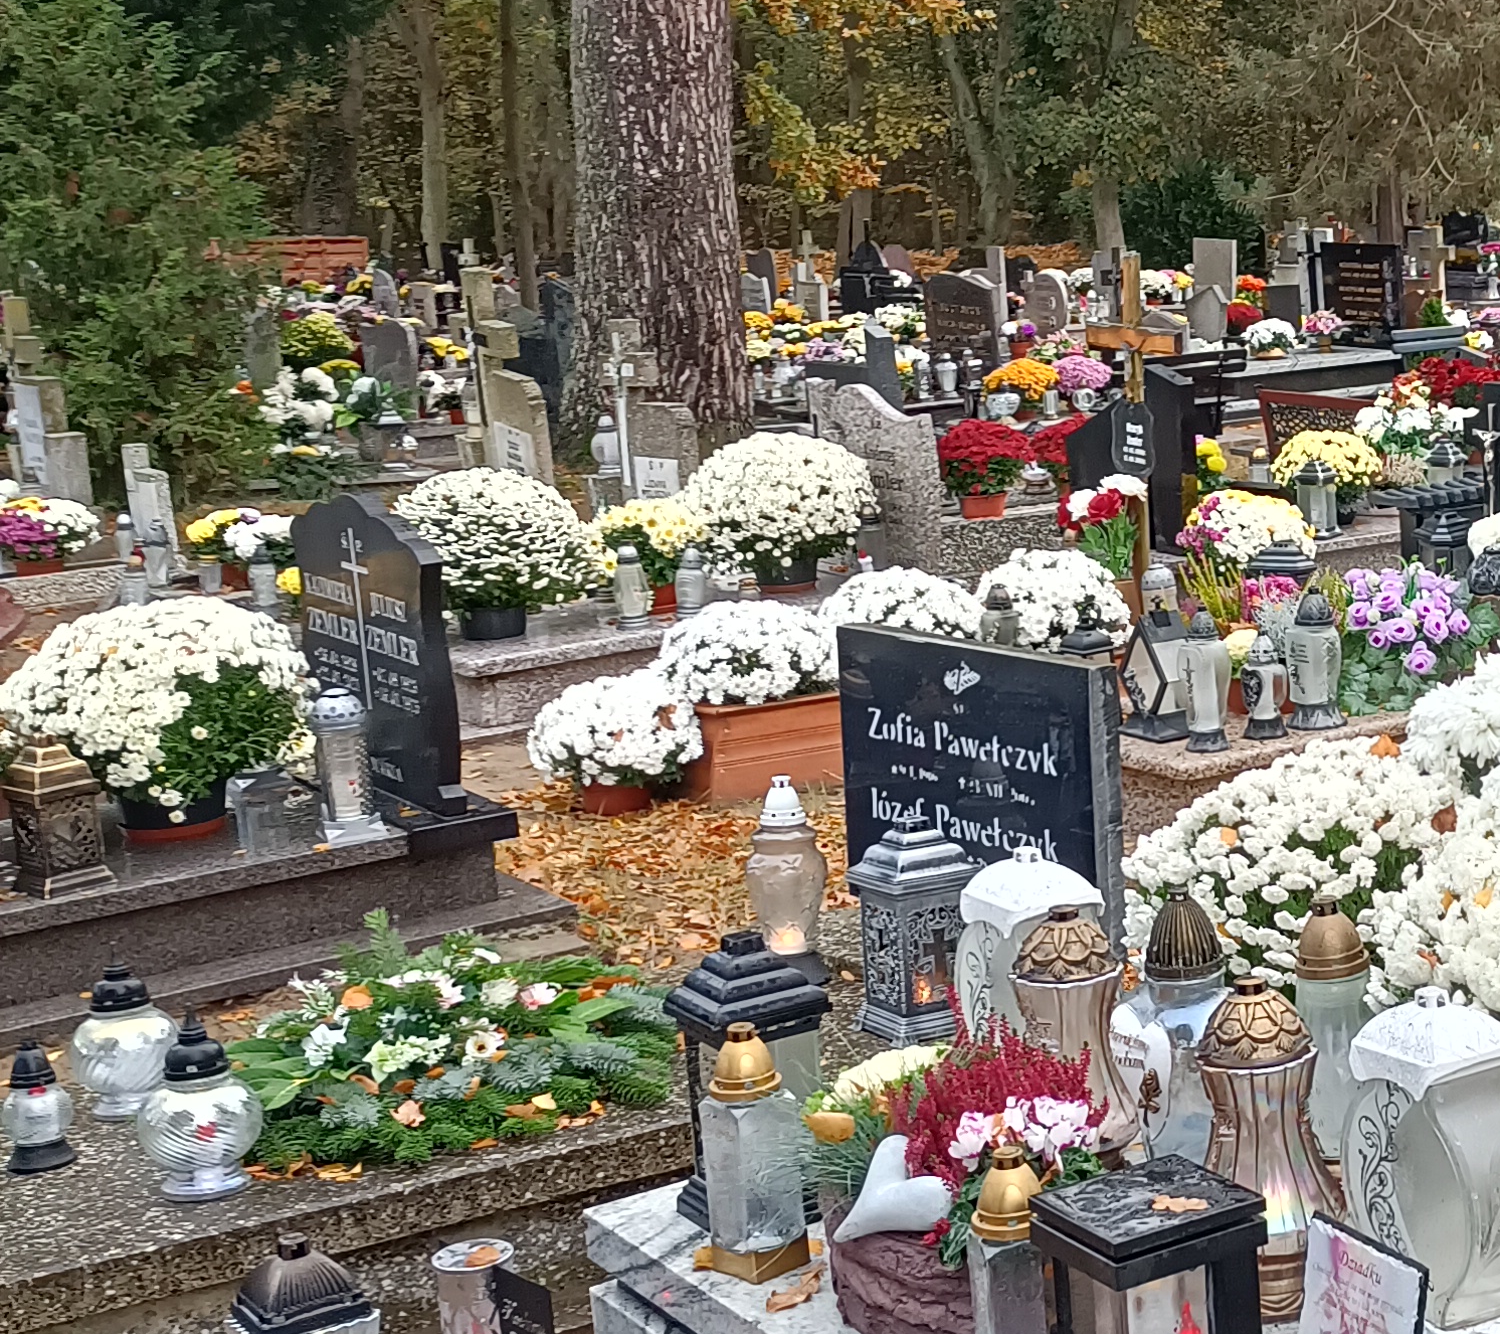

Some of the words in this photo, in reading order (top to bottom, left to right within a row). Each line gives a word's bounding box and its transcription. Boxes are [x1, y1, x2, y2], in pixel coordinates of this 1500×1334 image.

[867, 706, 927, 750] Zofia
[933, 720, 1058, 778] Pawełczyk
[935, 803, 1060, 864] Pawełczyk
[1339, 1249, 1382, 1287] Dziadku
